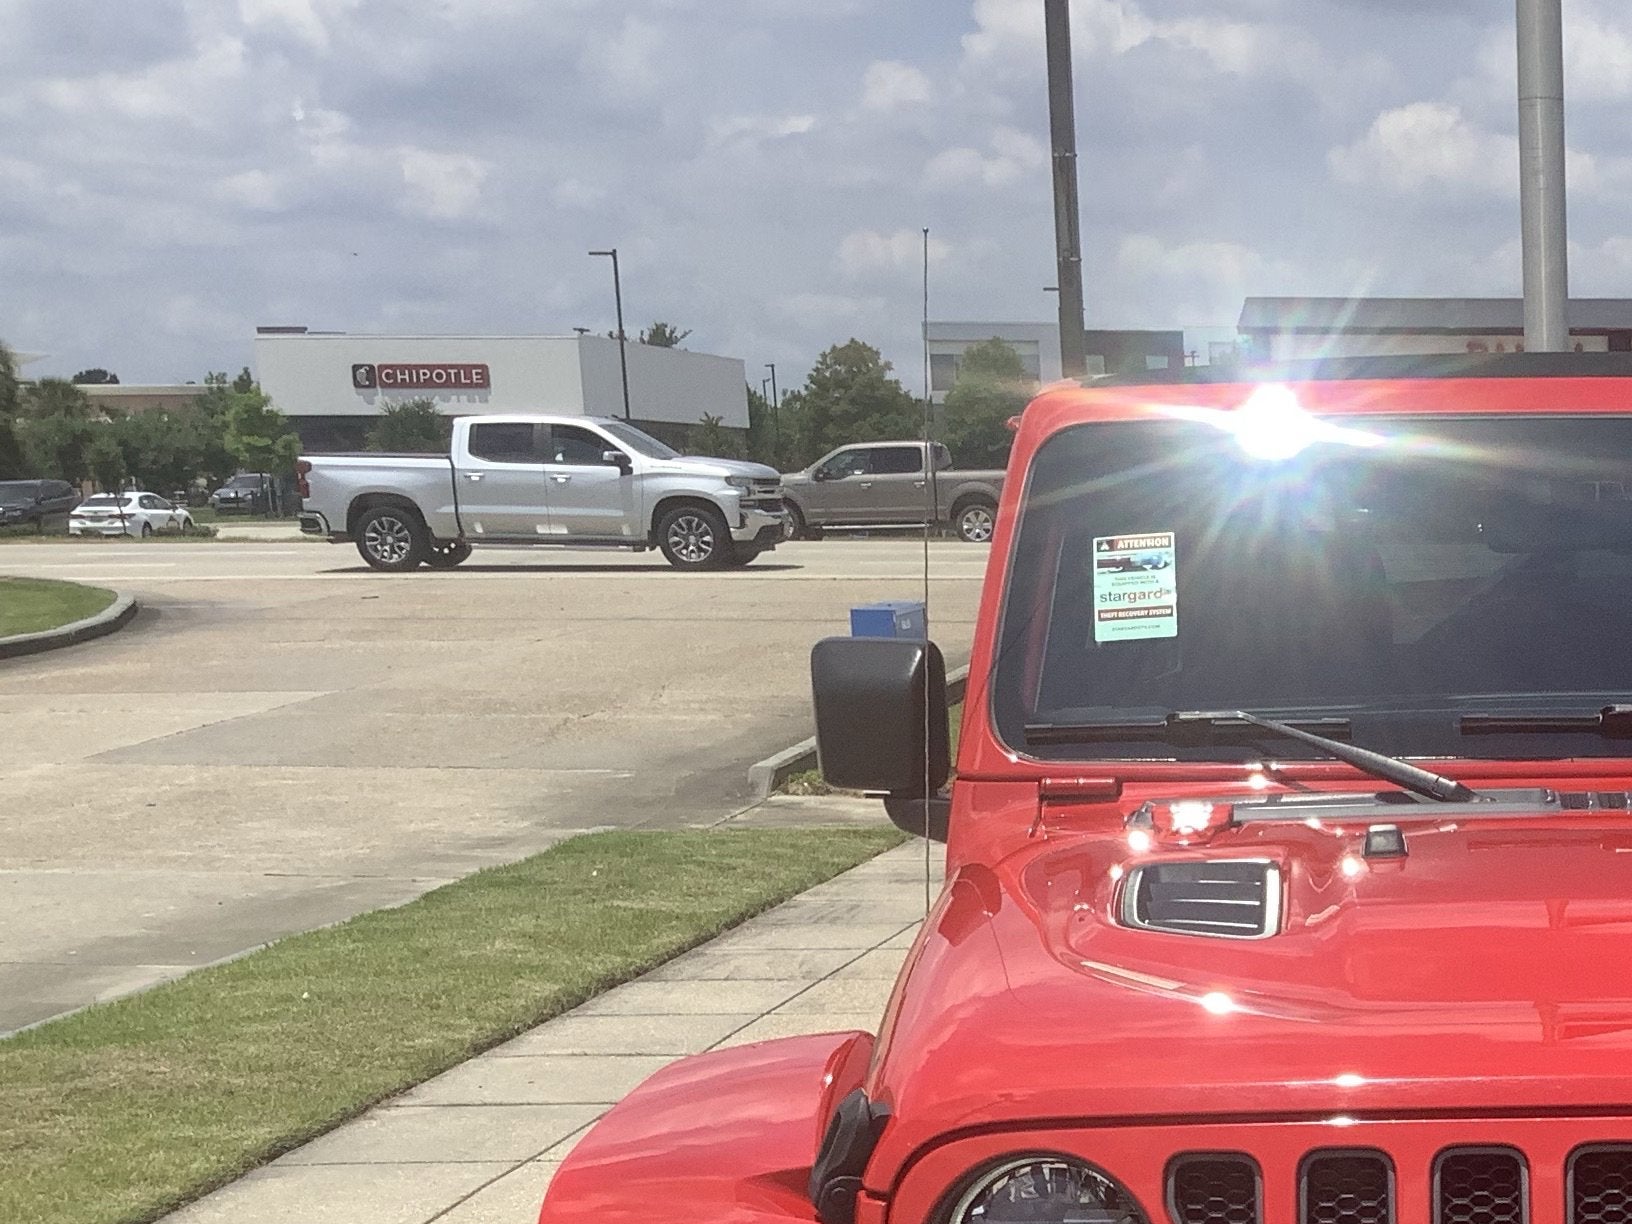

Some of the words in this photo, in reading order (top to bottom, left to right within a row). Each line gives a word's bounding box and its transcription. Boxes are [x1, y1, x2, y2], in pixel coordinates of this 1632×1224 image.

[381, 368, 484, 384] CHIPOTLE
[1117, 536, 1169, 549] ATTENTION
[1100, 587, 1163, 603] stargard
[1100, 610, 1118, 619] THEFT
[1118, 608, 1148, 618] RECOVERY
[1148, 607, 1172, 617] SYSTEM
